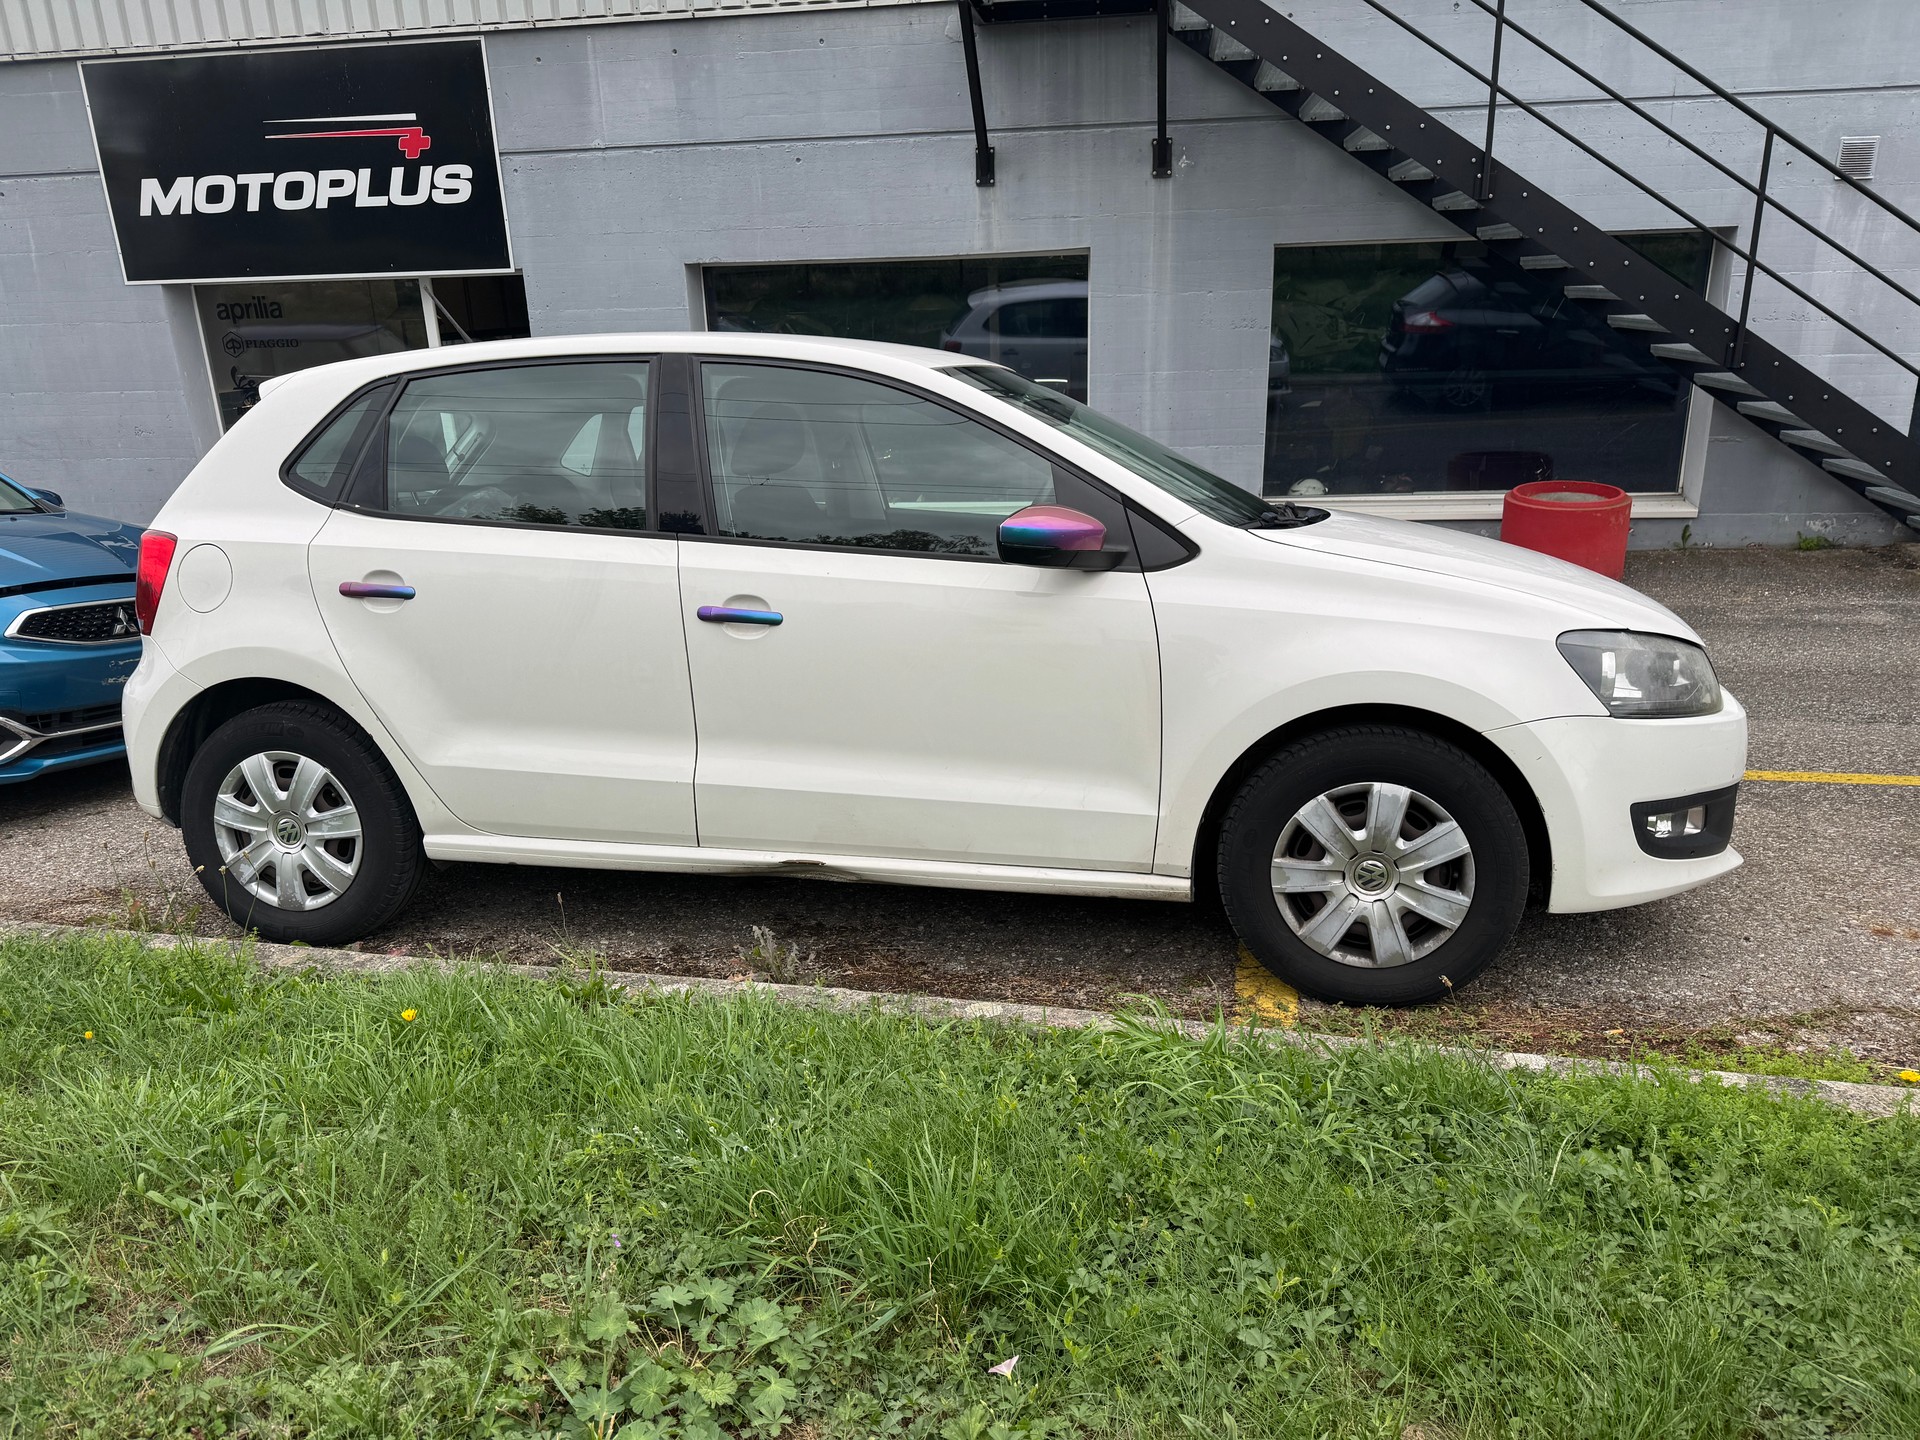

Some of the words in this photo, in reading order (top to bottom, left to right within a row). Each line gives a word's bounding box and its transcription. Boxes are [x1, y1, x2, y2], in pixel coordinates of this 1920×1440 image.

[139, 164, 472, 217] MOTOPLUS
[216, 296, 283, 324] aprilia
[245, 338, 299, 349] PIAGGIO
